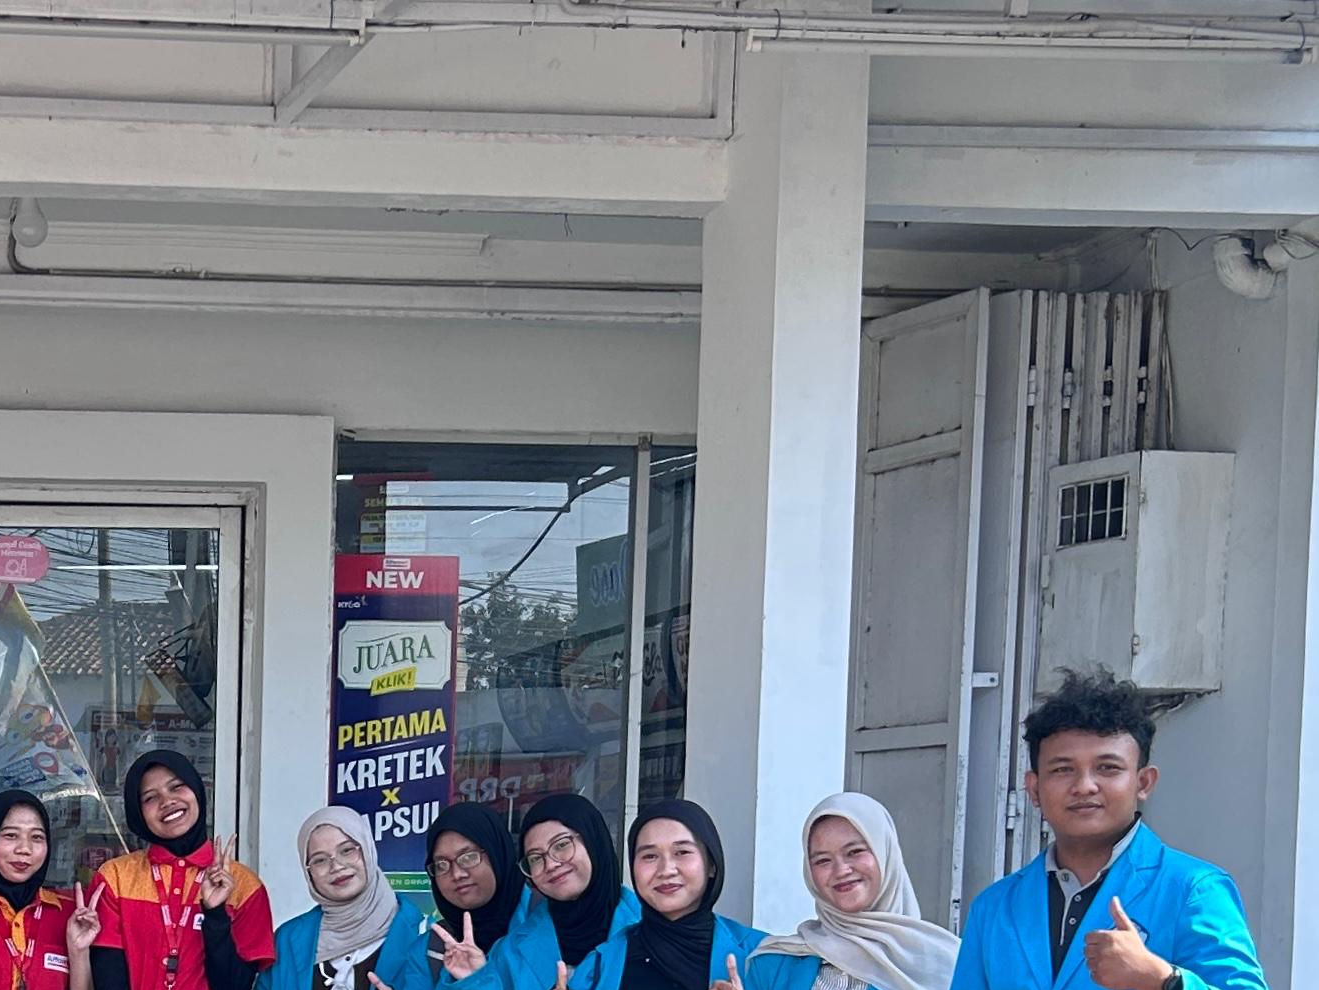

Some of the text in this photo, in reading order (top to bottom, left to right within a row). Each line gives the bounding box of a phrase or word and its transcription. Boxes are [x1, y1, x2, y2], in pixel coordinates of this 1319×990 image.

[366, 571, 424, 589] NEW
[353, 634, 436, 674] JUARA
[376, 673, 413, 690] KLIK!
[337, 708, 447, 750] PERTAMA
[336, 745, 446, 794] KRETEK
